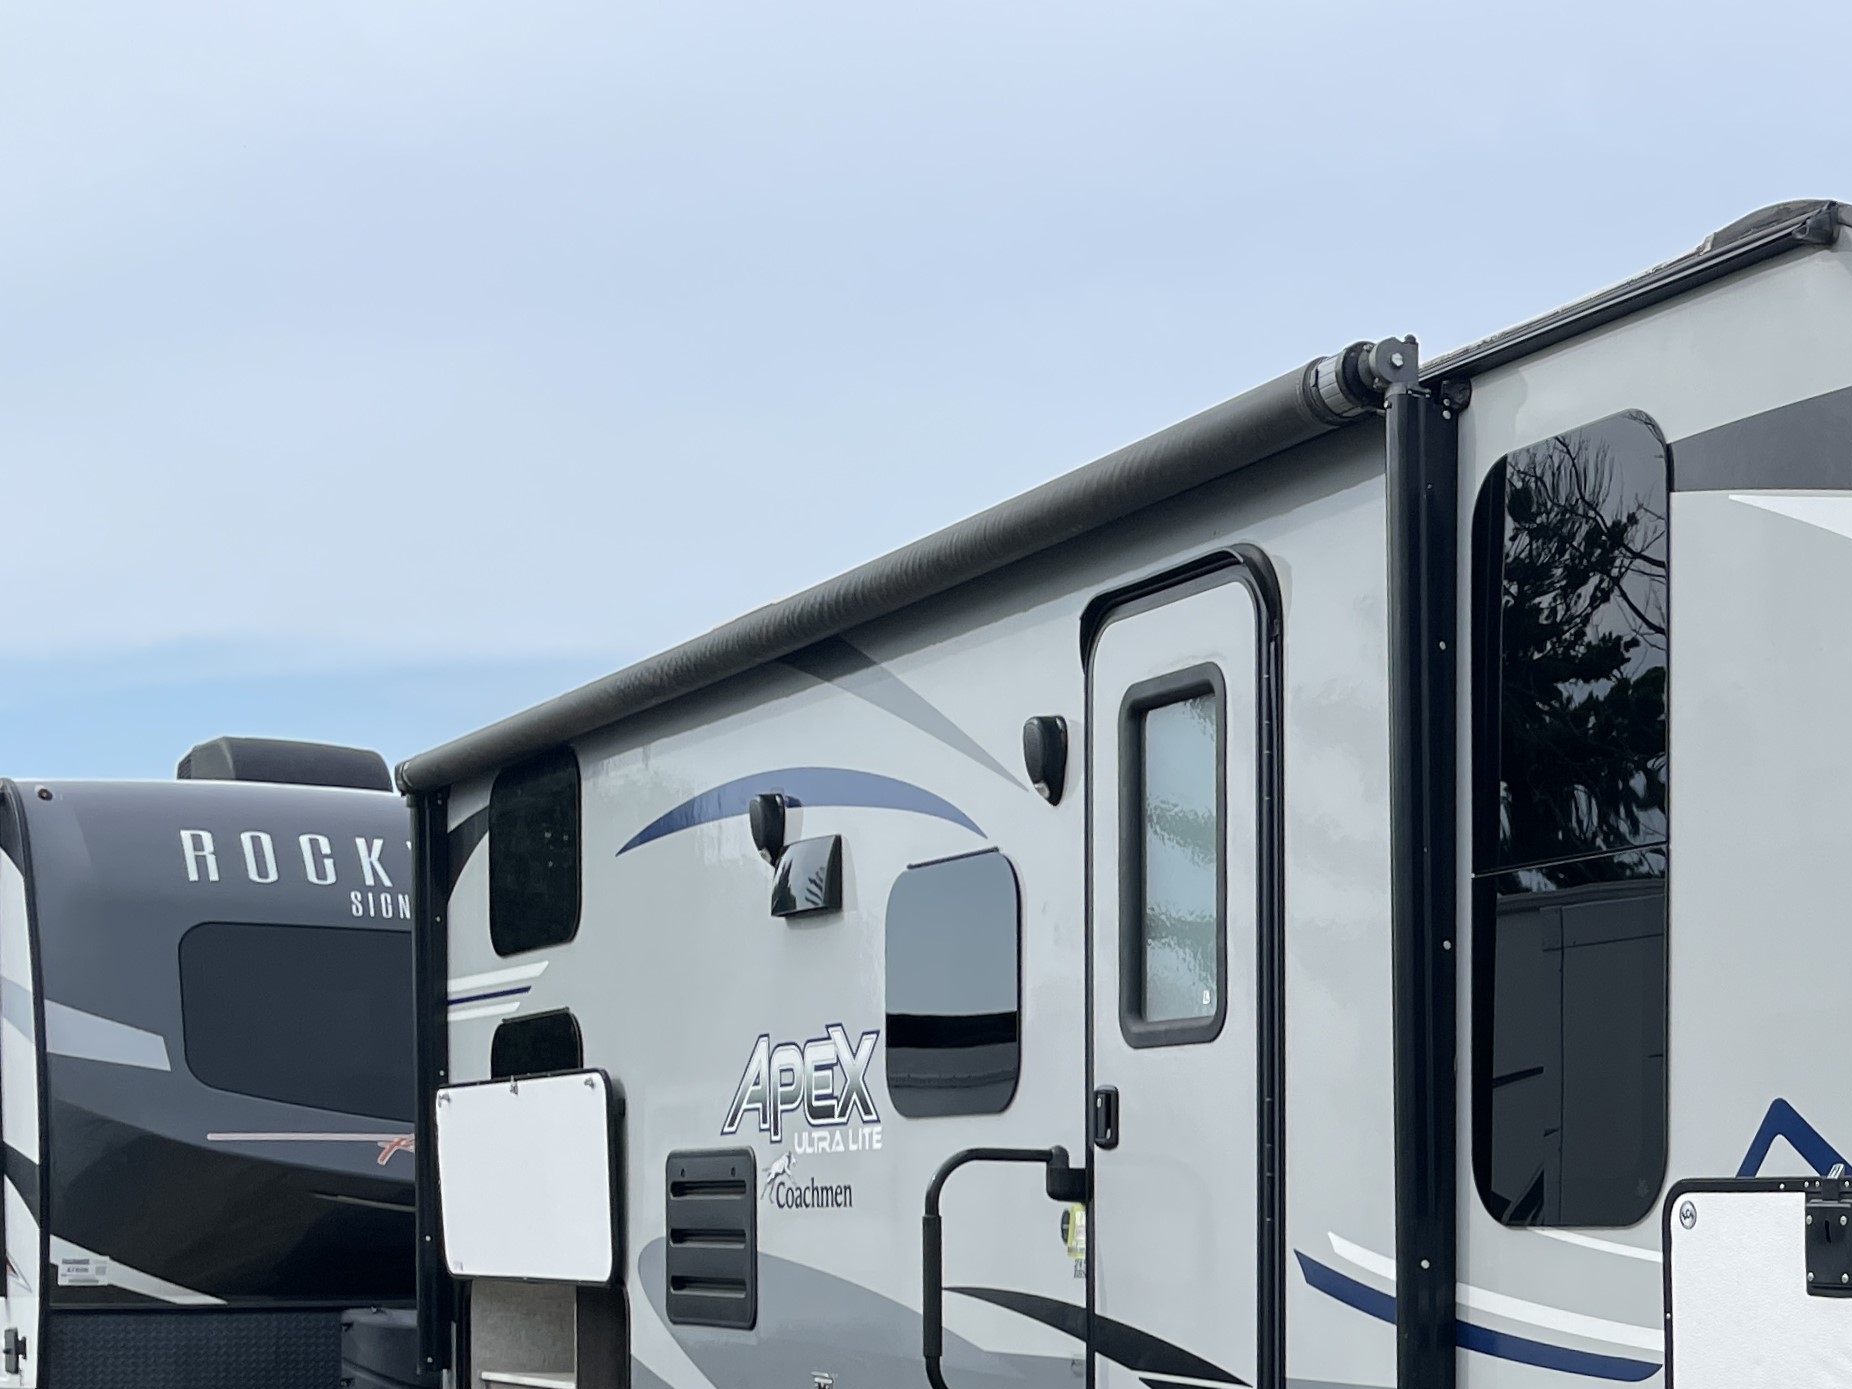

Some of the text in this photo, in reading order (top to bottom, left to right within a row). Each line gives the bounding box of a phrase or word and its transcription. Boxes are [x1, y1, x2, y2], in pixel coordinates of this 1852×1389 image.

[179, 829, 412, 888] ROCK
[720, 1022, 881, 1144] APEX
[794, 1125, 883, 1155] ULTRA LITE
[775, 1177, 853, 1210] Coachmen
